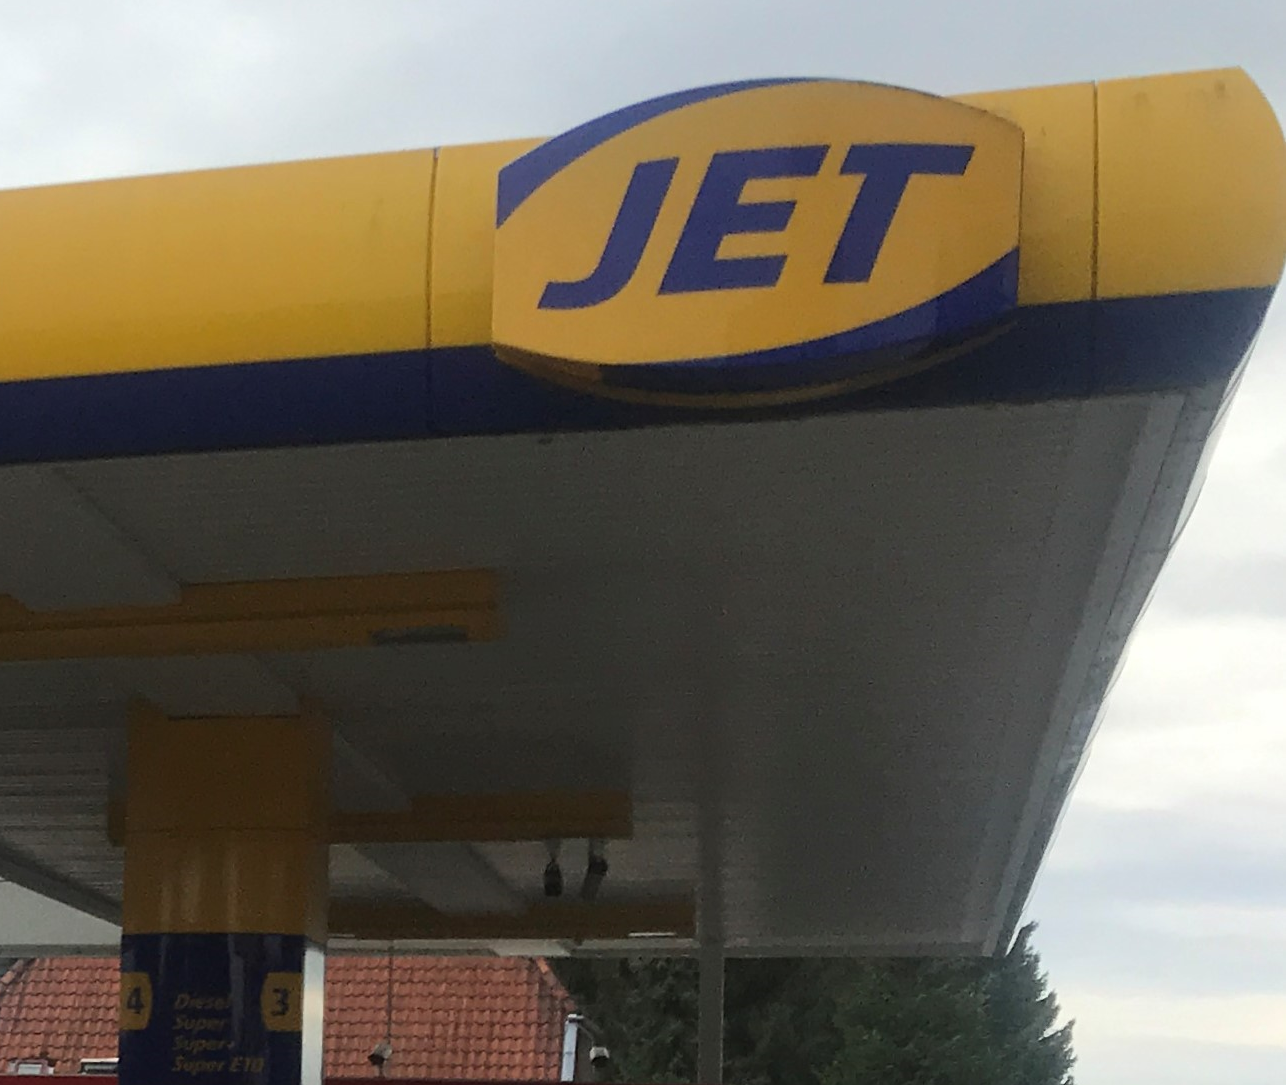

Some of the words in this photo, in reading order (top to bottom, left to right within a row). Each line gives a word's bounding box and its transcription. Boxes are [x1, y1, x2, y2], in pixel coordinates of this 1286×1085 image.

[537, 144, 975, 310] JET
[127, 987, 144, 1015] 4
[271, 988, 289, 1016] 3
[172, 1015, 226, 1034] Super
[172, 1055, 225, 1076] Super
[229, 1056, 265, 1073] E10
